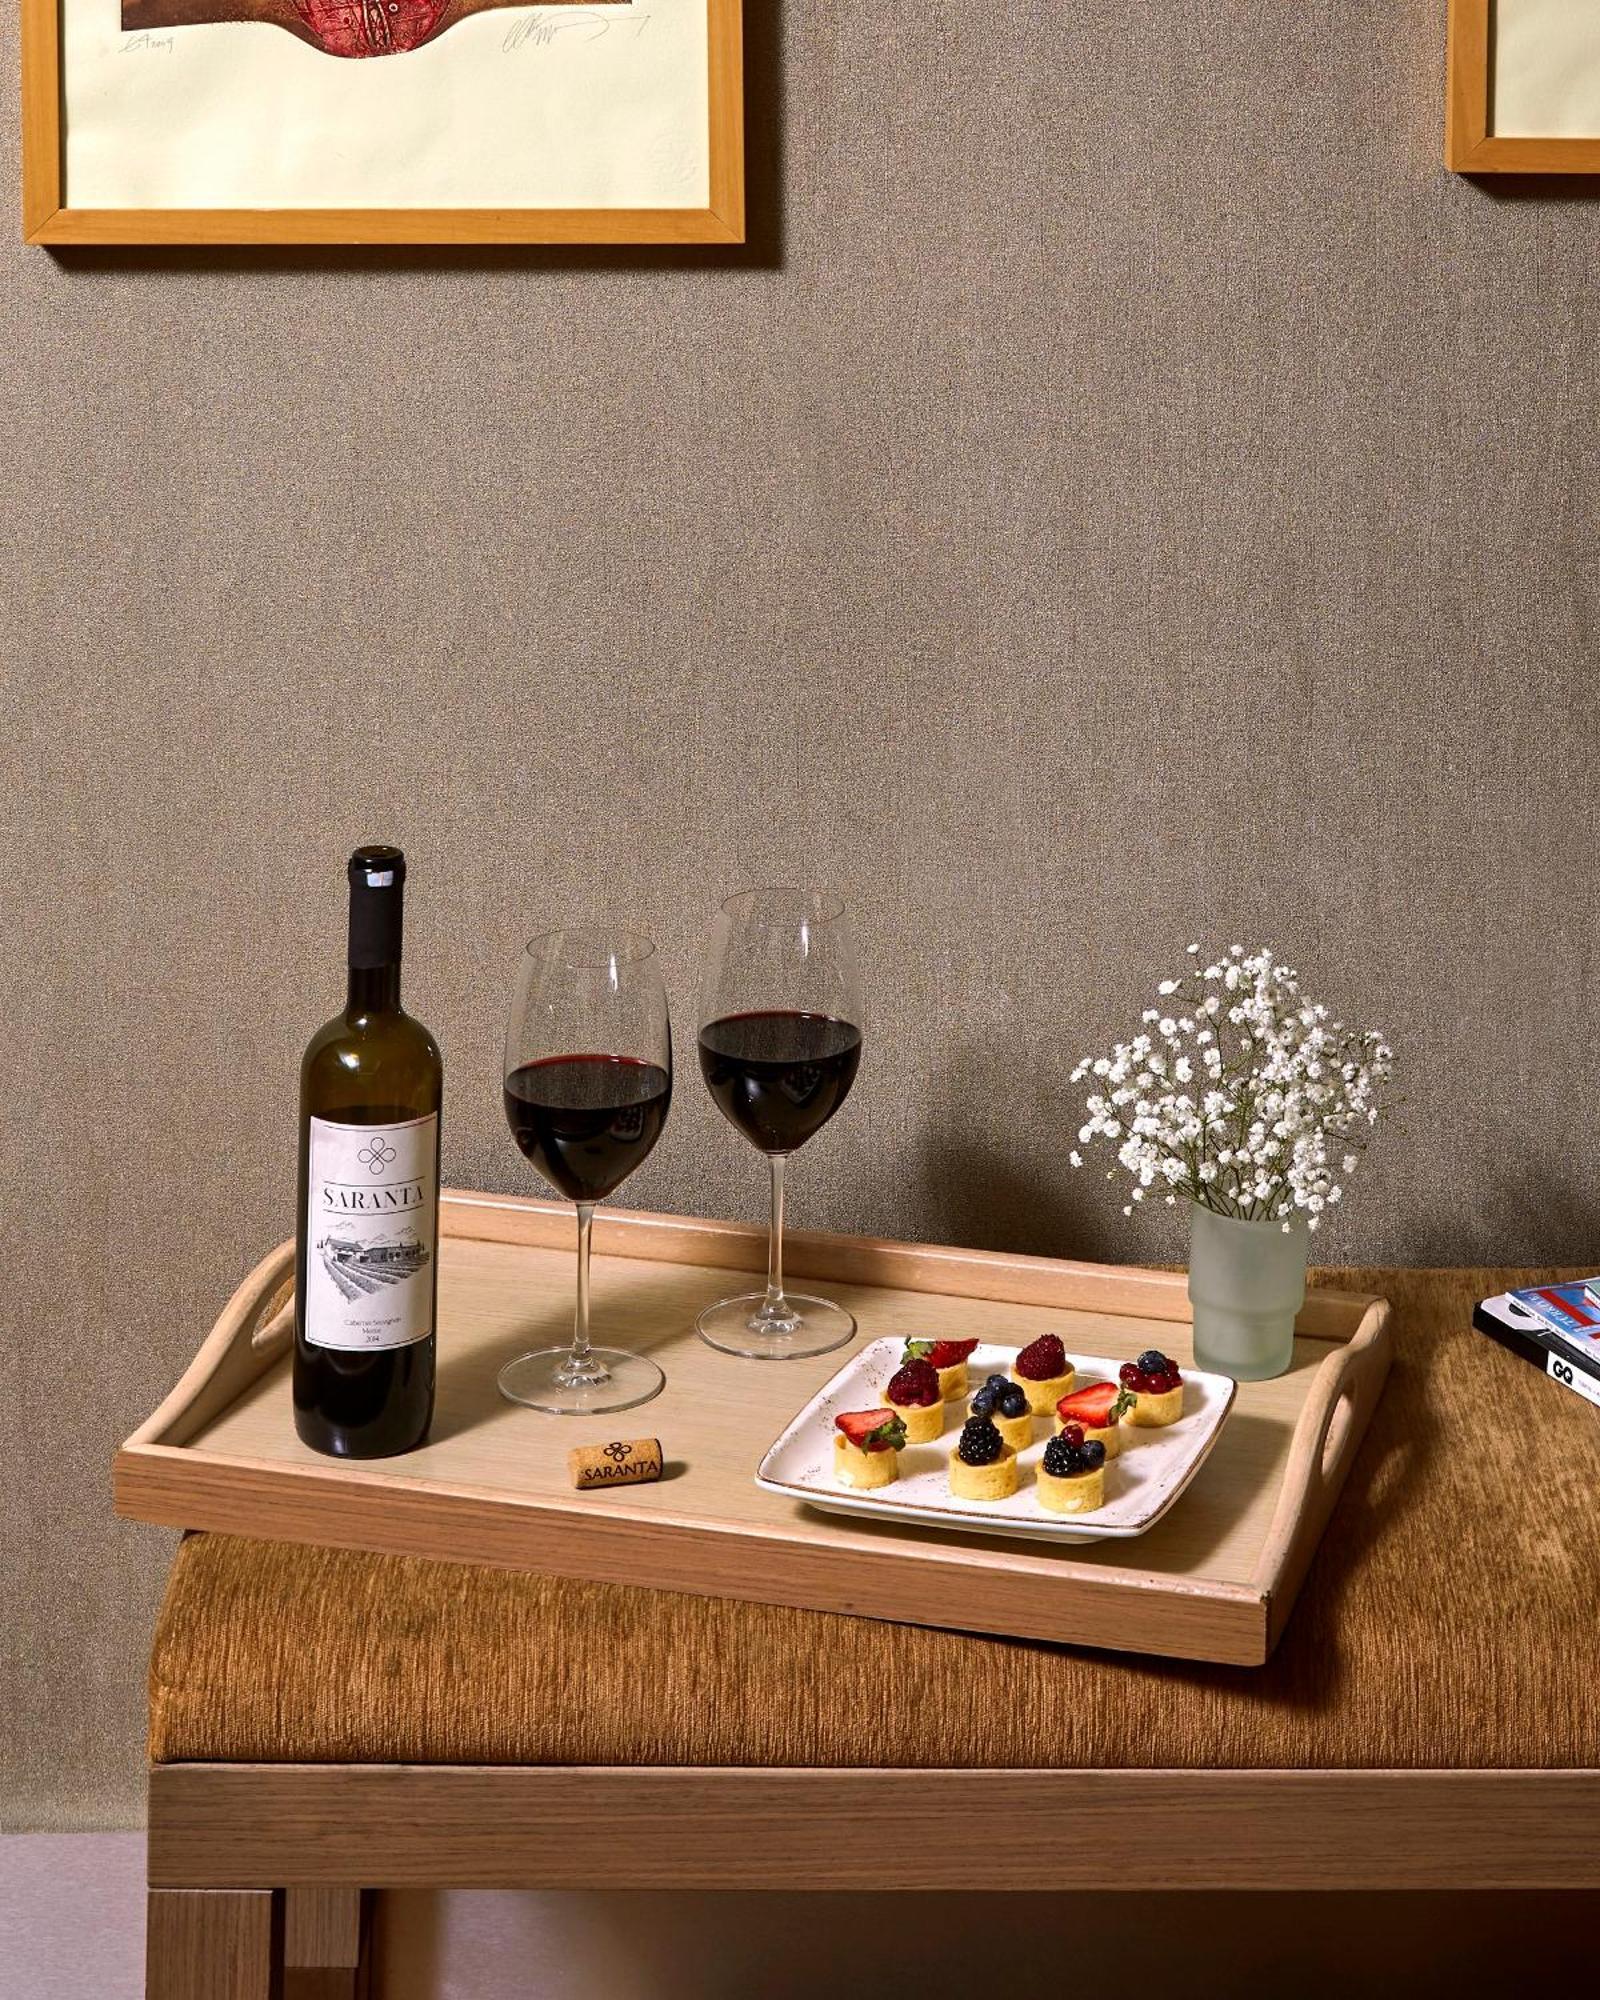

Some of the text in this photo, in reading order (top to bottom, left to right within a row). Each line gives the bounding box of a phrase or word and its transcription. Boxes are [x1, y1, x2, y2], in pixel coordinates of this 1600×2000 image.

[323, 1185, 424, 1209] SARANTA
[1553, 1360, 1574, 1386] GQ
[584, 1460, 658, 1481] SARANTA
